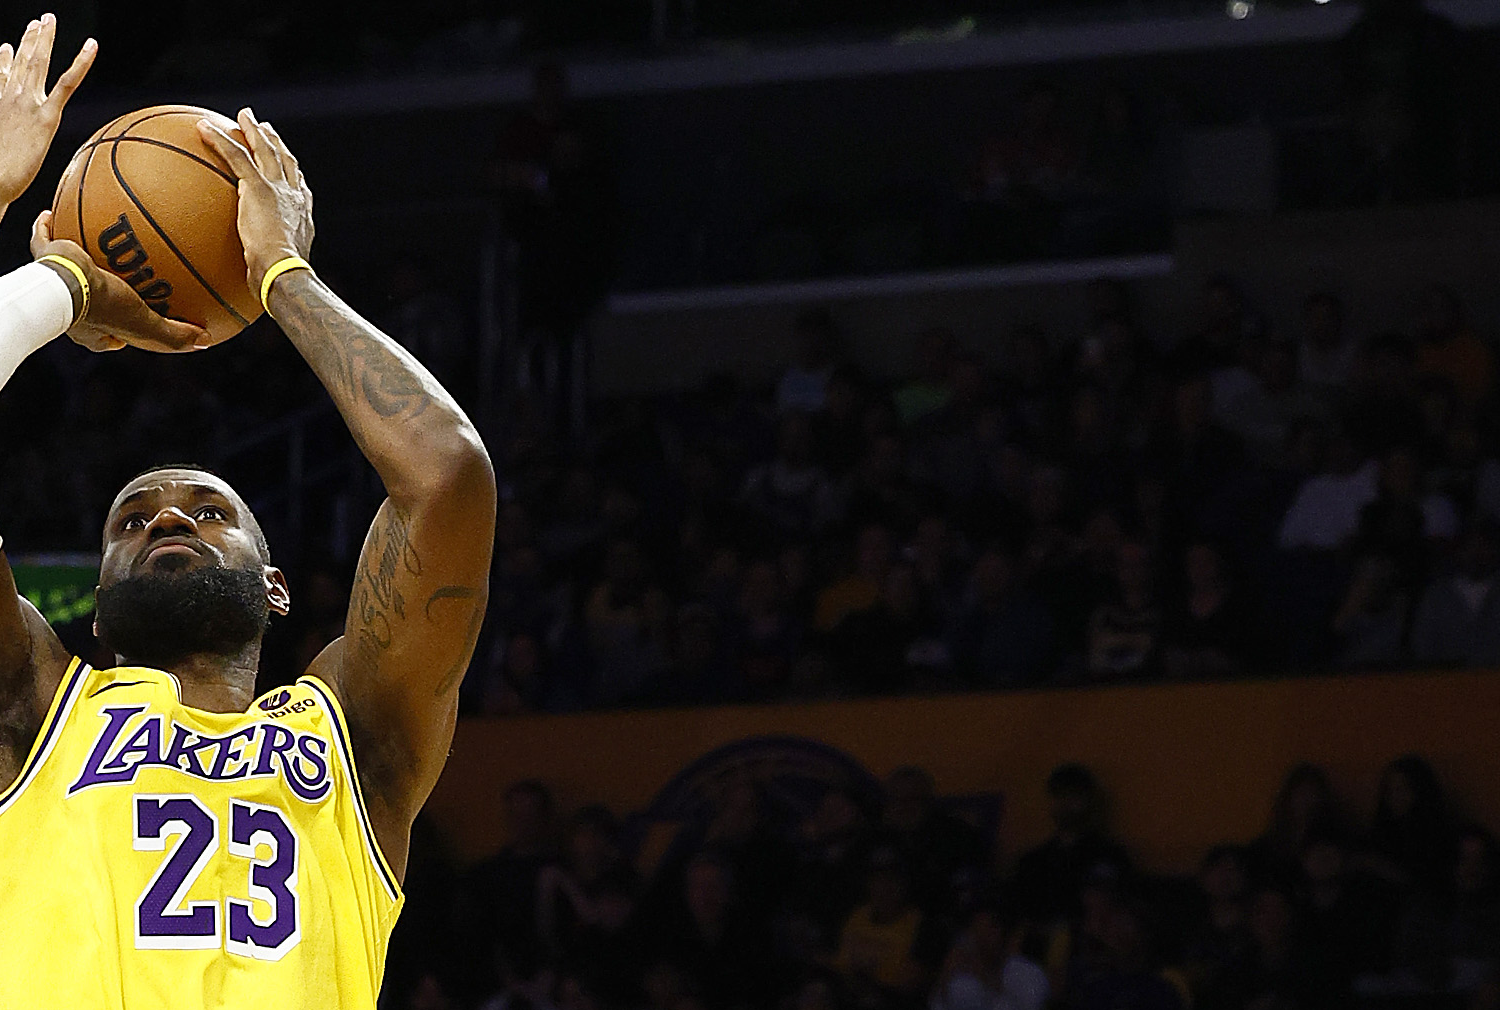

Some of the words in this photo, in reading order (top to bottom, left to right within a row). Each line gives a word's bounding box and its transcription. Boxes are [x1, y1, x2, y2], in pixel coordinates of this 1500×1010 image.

[98, 212, 176, 318] Wil
[66, 704, 333, 803] LAKERS
[266, 698, 316, 719] ibigo
[132, 793, 301, 961] 23
